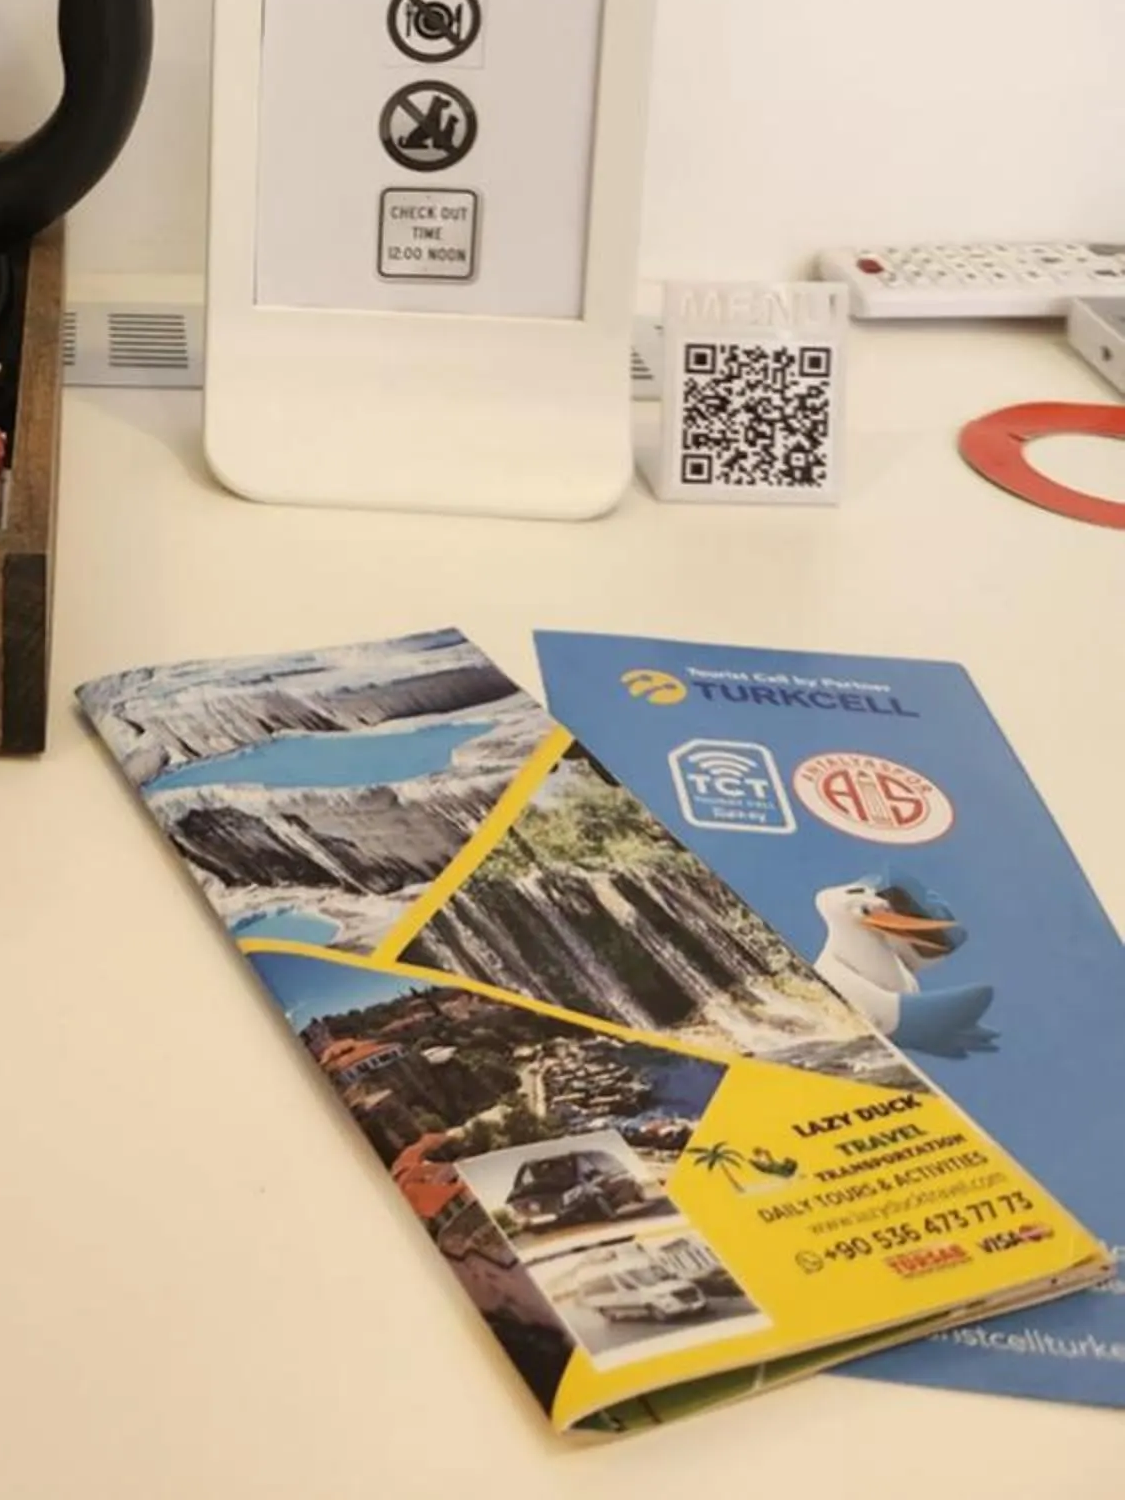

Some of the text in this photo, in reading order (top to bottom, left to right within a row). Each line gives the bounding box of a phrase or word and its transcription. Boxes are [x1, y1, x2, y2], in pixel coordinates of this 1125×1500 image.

[390, 206, 468, 220] CHECK OUT
[412, 226, 442, 240] TIME
[428, 248, 466, 261] NOON
[693, 681, 921, 718] TURKCELL
[686, 773, 769, 799] TCT
[792, 1094, 923, 1138] LAZY DUCK
[834, 1123, 928, 1157] TRAVEL
[813, 1133, 968, 1183] TRANSPORTATION
[757, 1150, 989, 1224] DAILY TOURS & ACTIVITIES
[824, 1190, 1034, 1261] +90 536 473 77 73
[977, 1230, 1025, 1254] VISA
